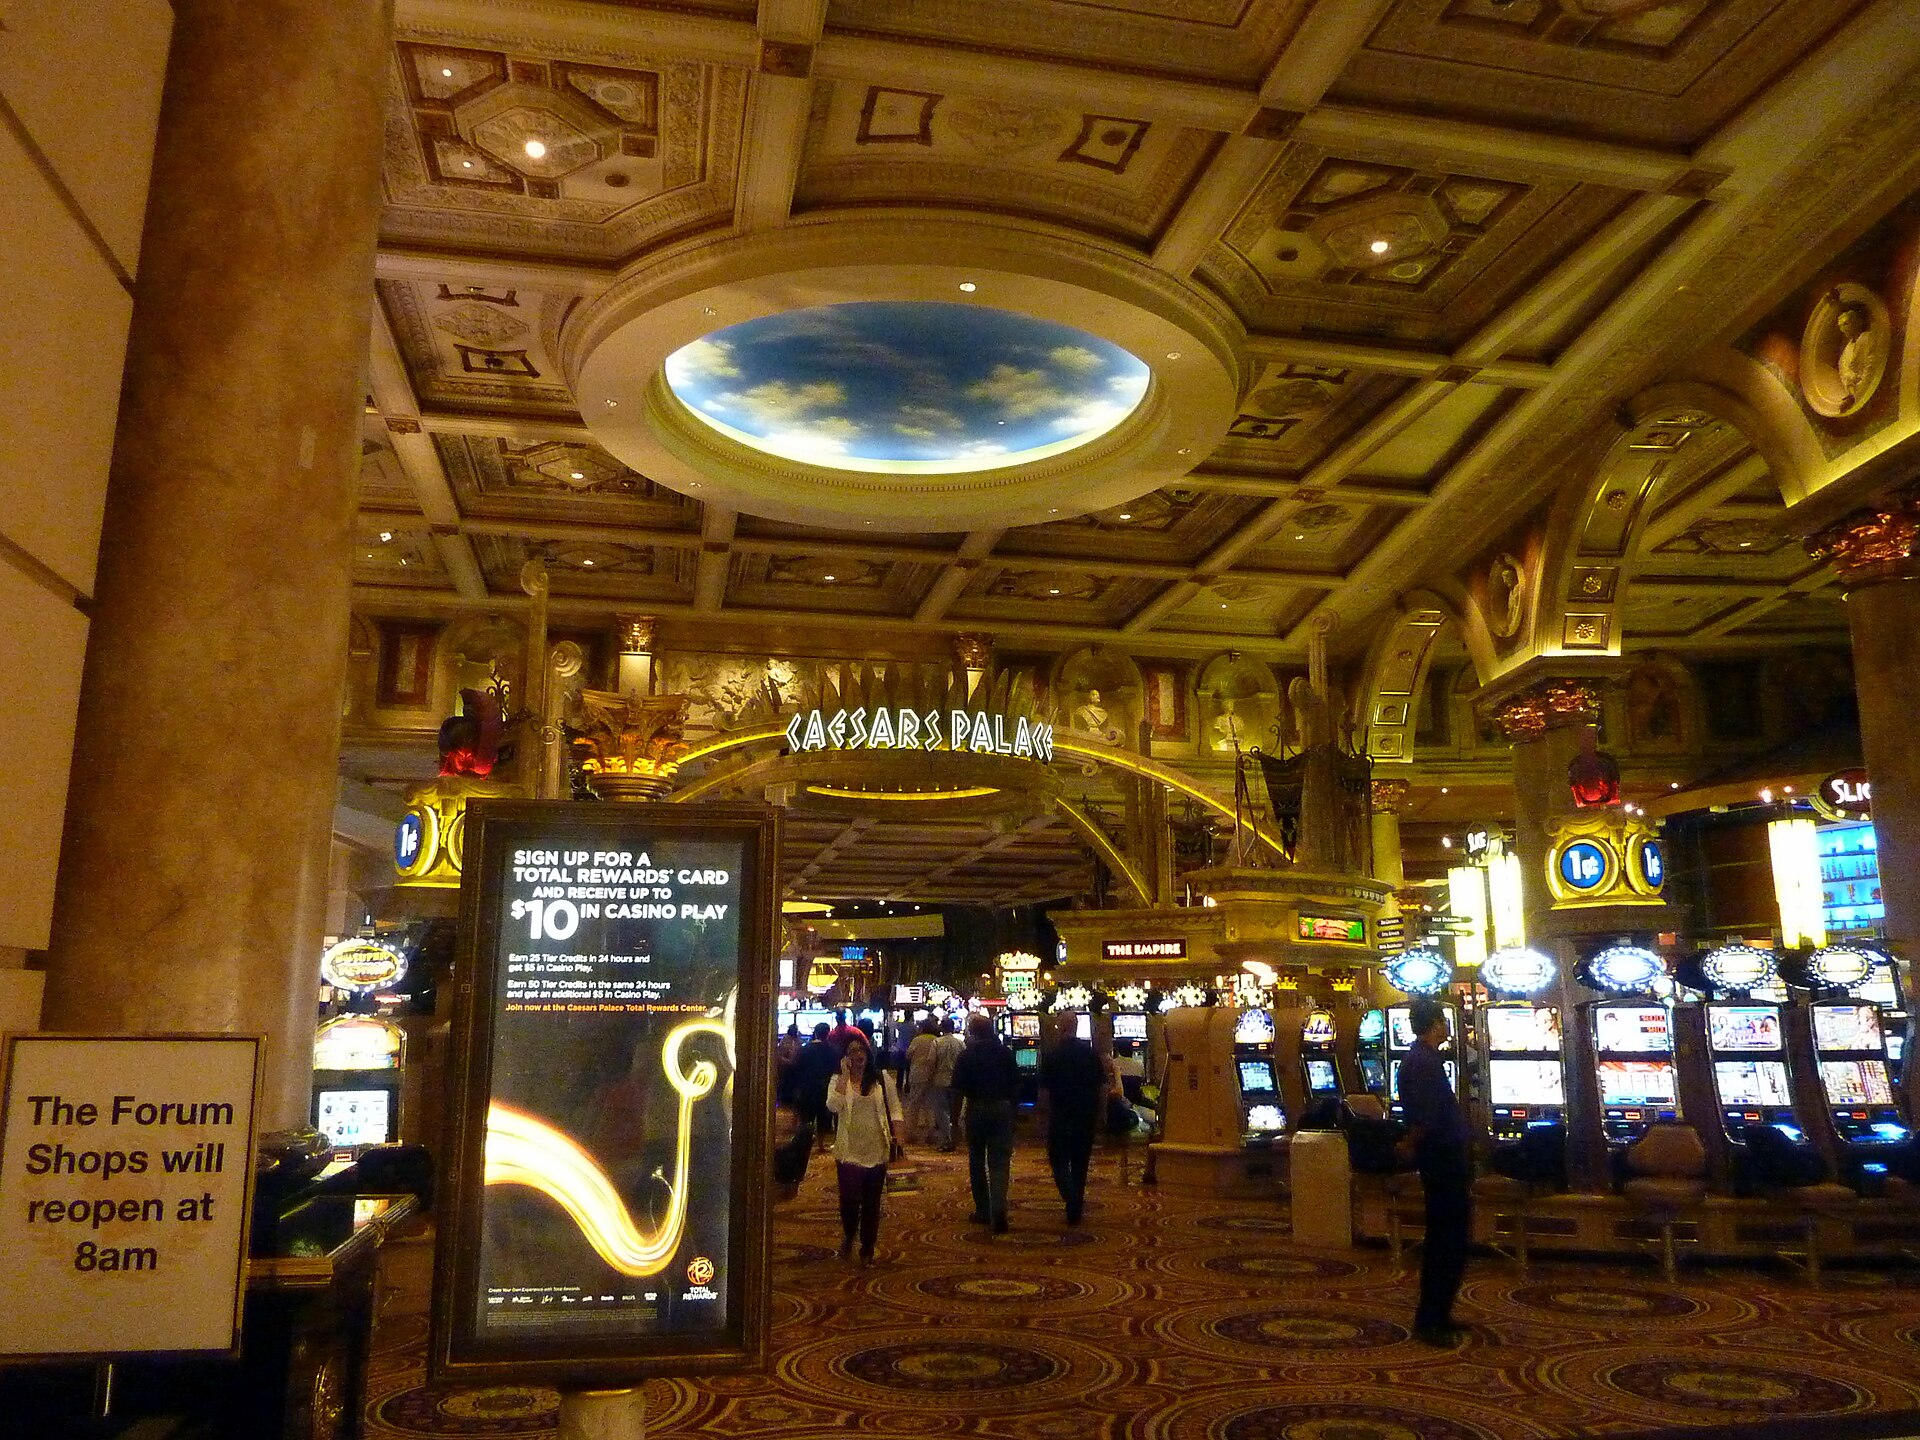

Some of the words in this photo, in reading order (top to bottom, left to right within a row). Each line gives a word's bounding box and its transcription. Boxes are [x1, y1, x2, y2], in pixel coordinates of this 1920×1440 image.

[786, 707, 943, 752] CAESARS
[951, 709, 1053, 762] PALACE
[514, 850, 559, 866] SIGN
[563, 851, 590, 866] UP
[593, 851, 633, 867] FOR
[636, 852, 652, 867] A
[1569, 850, 1599, 880] 1¢
[1644, 847, 1661, 878] 1¢
[512, 867, 573, 883] TOTAL
[677, 869, 730, 885] CARD
[532, 886, 565, 898] AND
[567, 887, 627, 899] RECEIVE
[629, 887, 650, 900] UP
[652, 887, 673, 900] TO
[510, 899, 579, 941] $10
[580, 903, 600, 919] IN
[604, 903, 677, 919] CASINO
[680, 904, 729, 920] PLAY
[1107, 944, 1133, 956] THE
[1134, 943, 1181, 955] EMPIRE
[509, 954, 528, 962] Earn
[530, 954, 540, 962] 25
[542, 954, 558, 962] Tier
[559, 954, 587, 962] Credits
[589, 954, 597, 962] in
[598, 954, 609, 962] 24
[610, 954, 633, 963] hours
[634, 955, 650, 963] and
[508, 964, 523, 973] get
[524, 963, 536, 973] $5
[536, 963, 545, 972] in
[546, 964, 573, 972] Casino
[574, 964, 593, 973] Play.
[507, 980, 527, 988] Earn
[528, 980, 539, 988] 50
[542, 980, 558, 988] Tier
[559, 980, 587, 988] Credits
[589, 980, 597, 988] in
[636, 981, 647, 989] 24
[648, 981, 671, 989] hours
[506, 990, 523, 998] and
[524, 991, 539, 999] get
[552, 990, 591, 998] additional
[593, 990, 604, 999] $5
[605, 990, 613, 998] in
[614, 990, 642, 999] Casino
[642, 990, 661, 1000] Play.
[505, 1003, 523, 1011] Join
[625, 1004, 645, 1012] Total
[646, 1004, 679, 1012] Rewards
[680, 1004, 708, 1012] Center.
[27, 1096, 98, 1126] The
[111, 1096, 234, 1126] Forum
[25, 1143, 149, 1180] Shops
[161, 1143, 225, 1174] will
[27, 1198, 164, 1229] reopen
[176, 1192, 214, 1222] at
[74, 1241, 158, 1272] 8am
[689, 1286, 709, 1294] TOTAL
